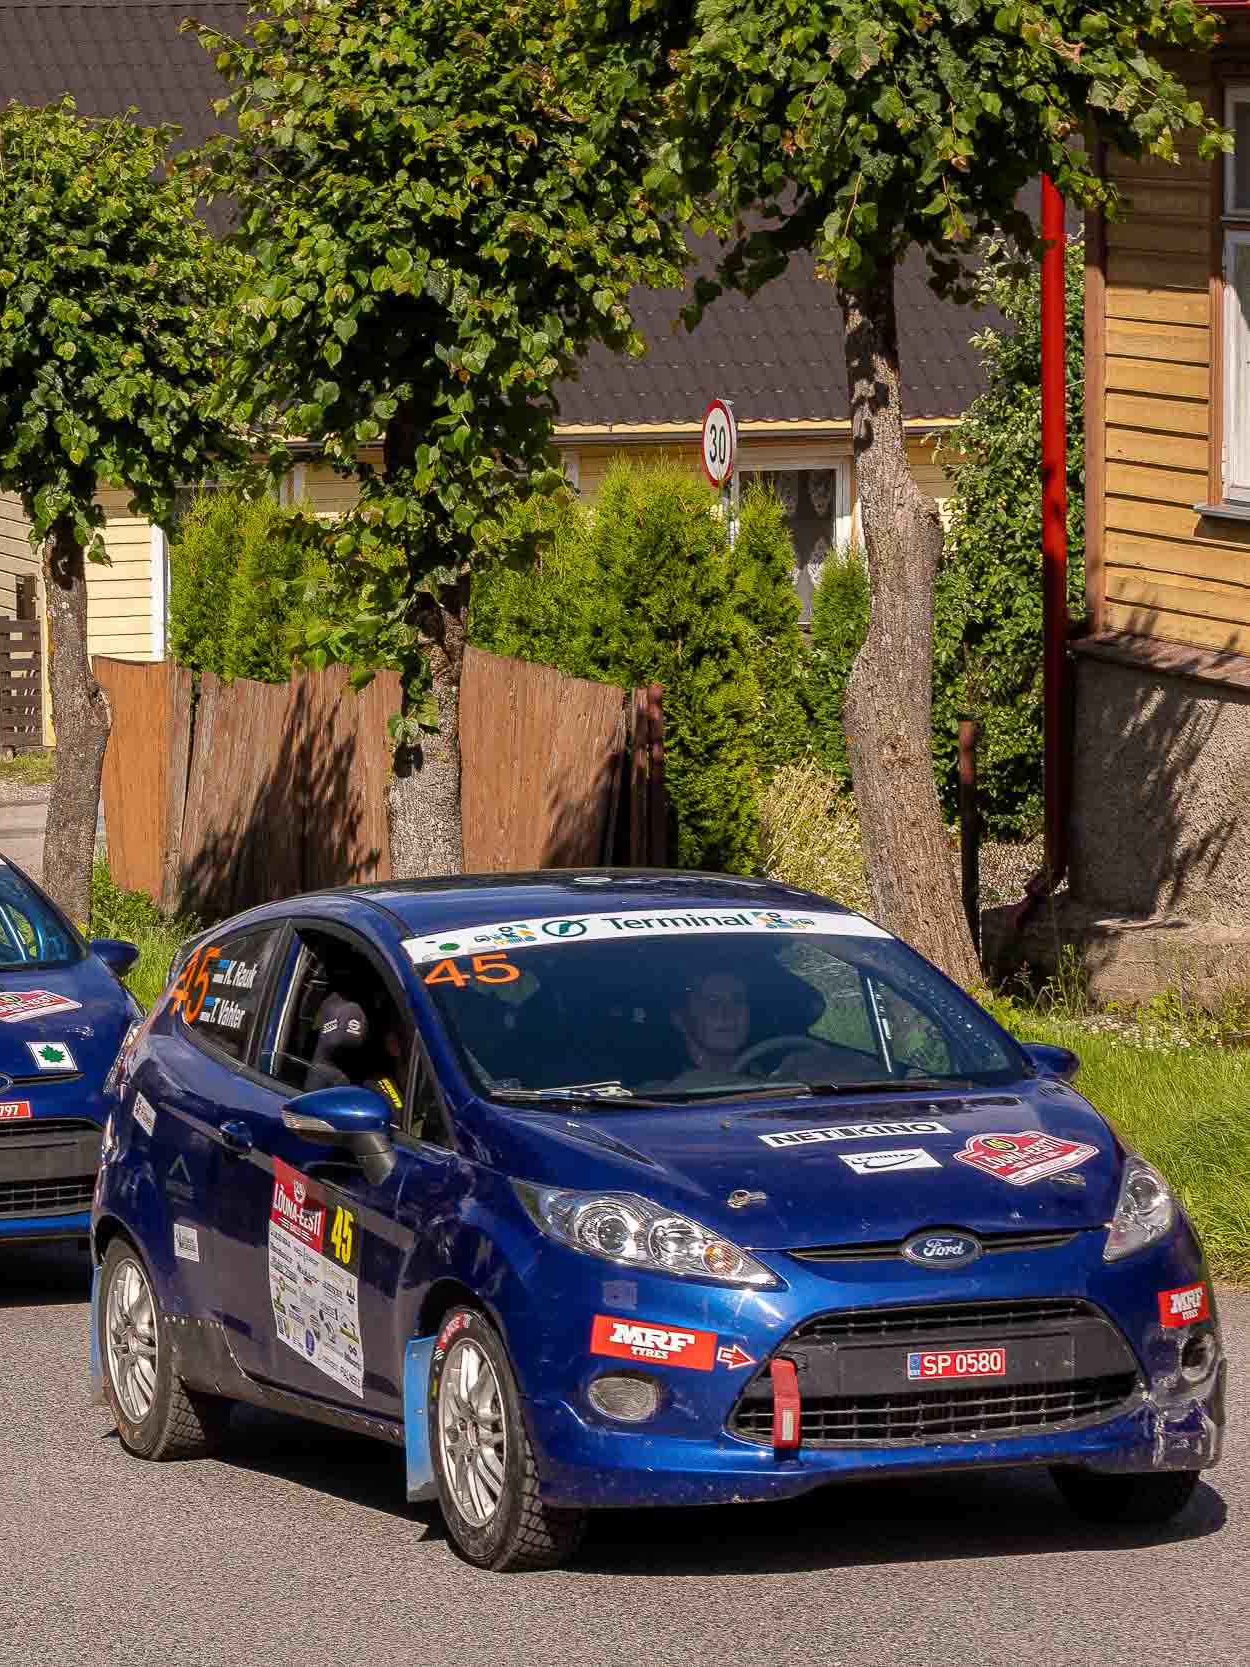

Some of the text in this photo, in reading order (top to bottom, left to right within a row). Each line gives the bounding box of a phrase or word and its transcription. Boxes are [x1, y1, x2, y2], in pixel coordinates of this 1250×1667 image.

[709, 423, 726, 464] 30
[600, 912, 753, 930] Terminal
[423, 953, 521, 988] 45
[331, 1205, 354, 1264] 45
[922, 1237, 965, 1257] Ford
[1170, 1287, 1203, 1313] MRF
[609, 1322, 695, 1352] MRF
[631, 1345, 669, 1360] TYRES
[923, 1352, 1001, 1375] SP 0580
